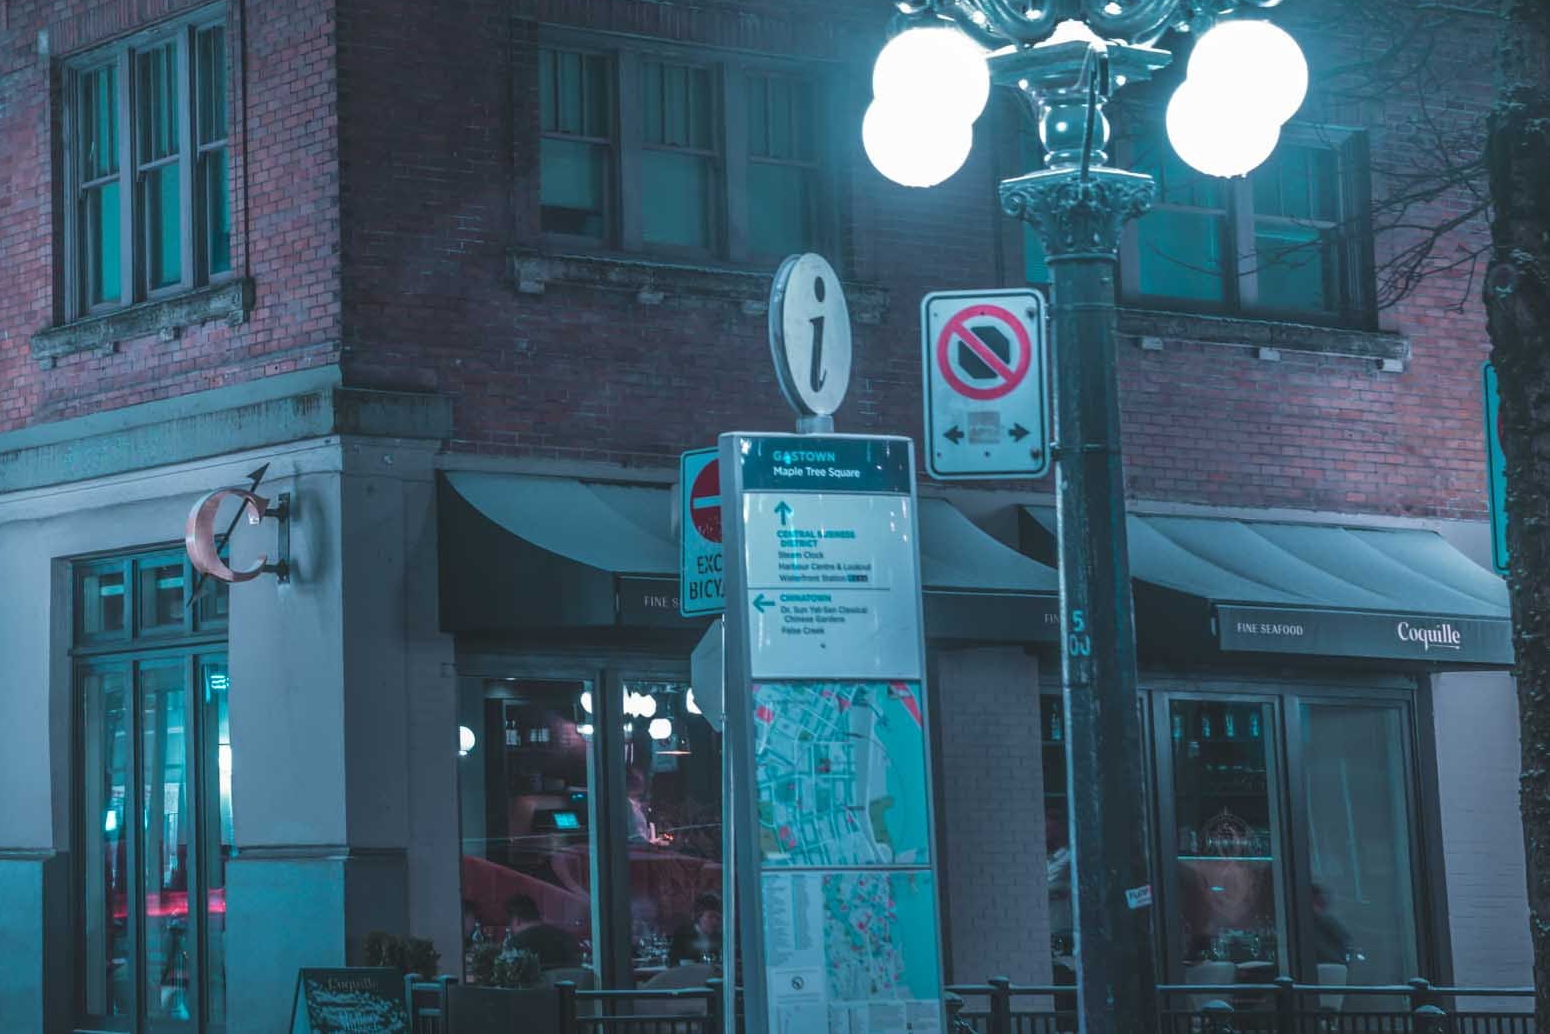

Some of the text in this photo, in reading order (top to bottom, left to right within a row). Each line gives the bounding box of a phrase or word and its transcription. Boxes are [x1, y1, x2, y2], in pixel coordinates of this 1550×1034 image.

[772, 450, 836, 464] GASTOWN
[772, 466, 861, 479] Maple Tree Square
[1236, 622, 1304, 636] FINE SEAFOOD
[1396, 621, 1462, 651] Coquille
